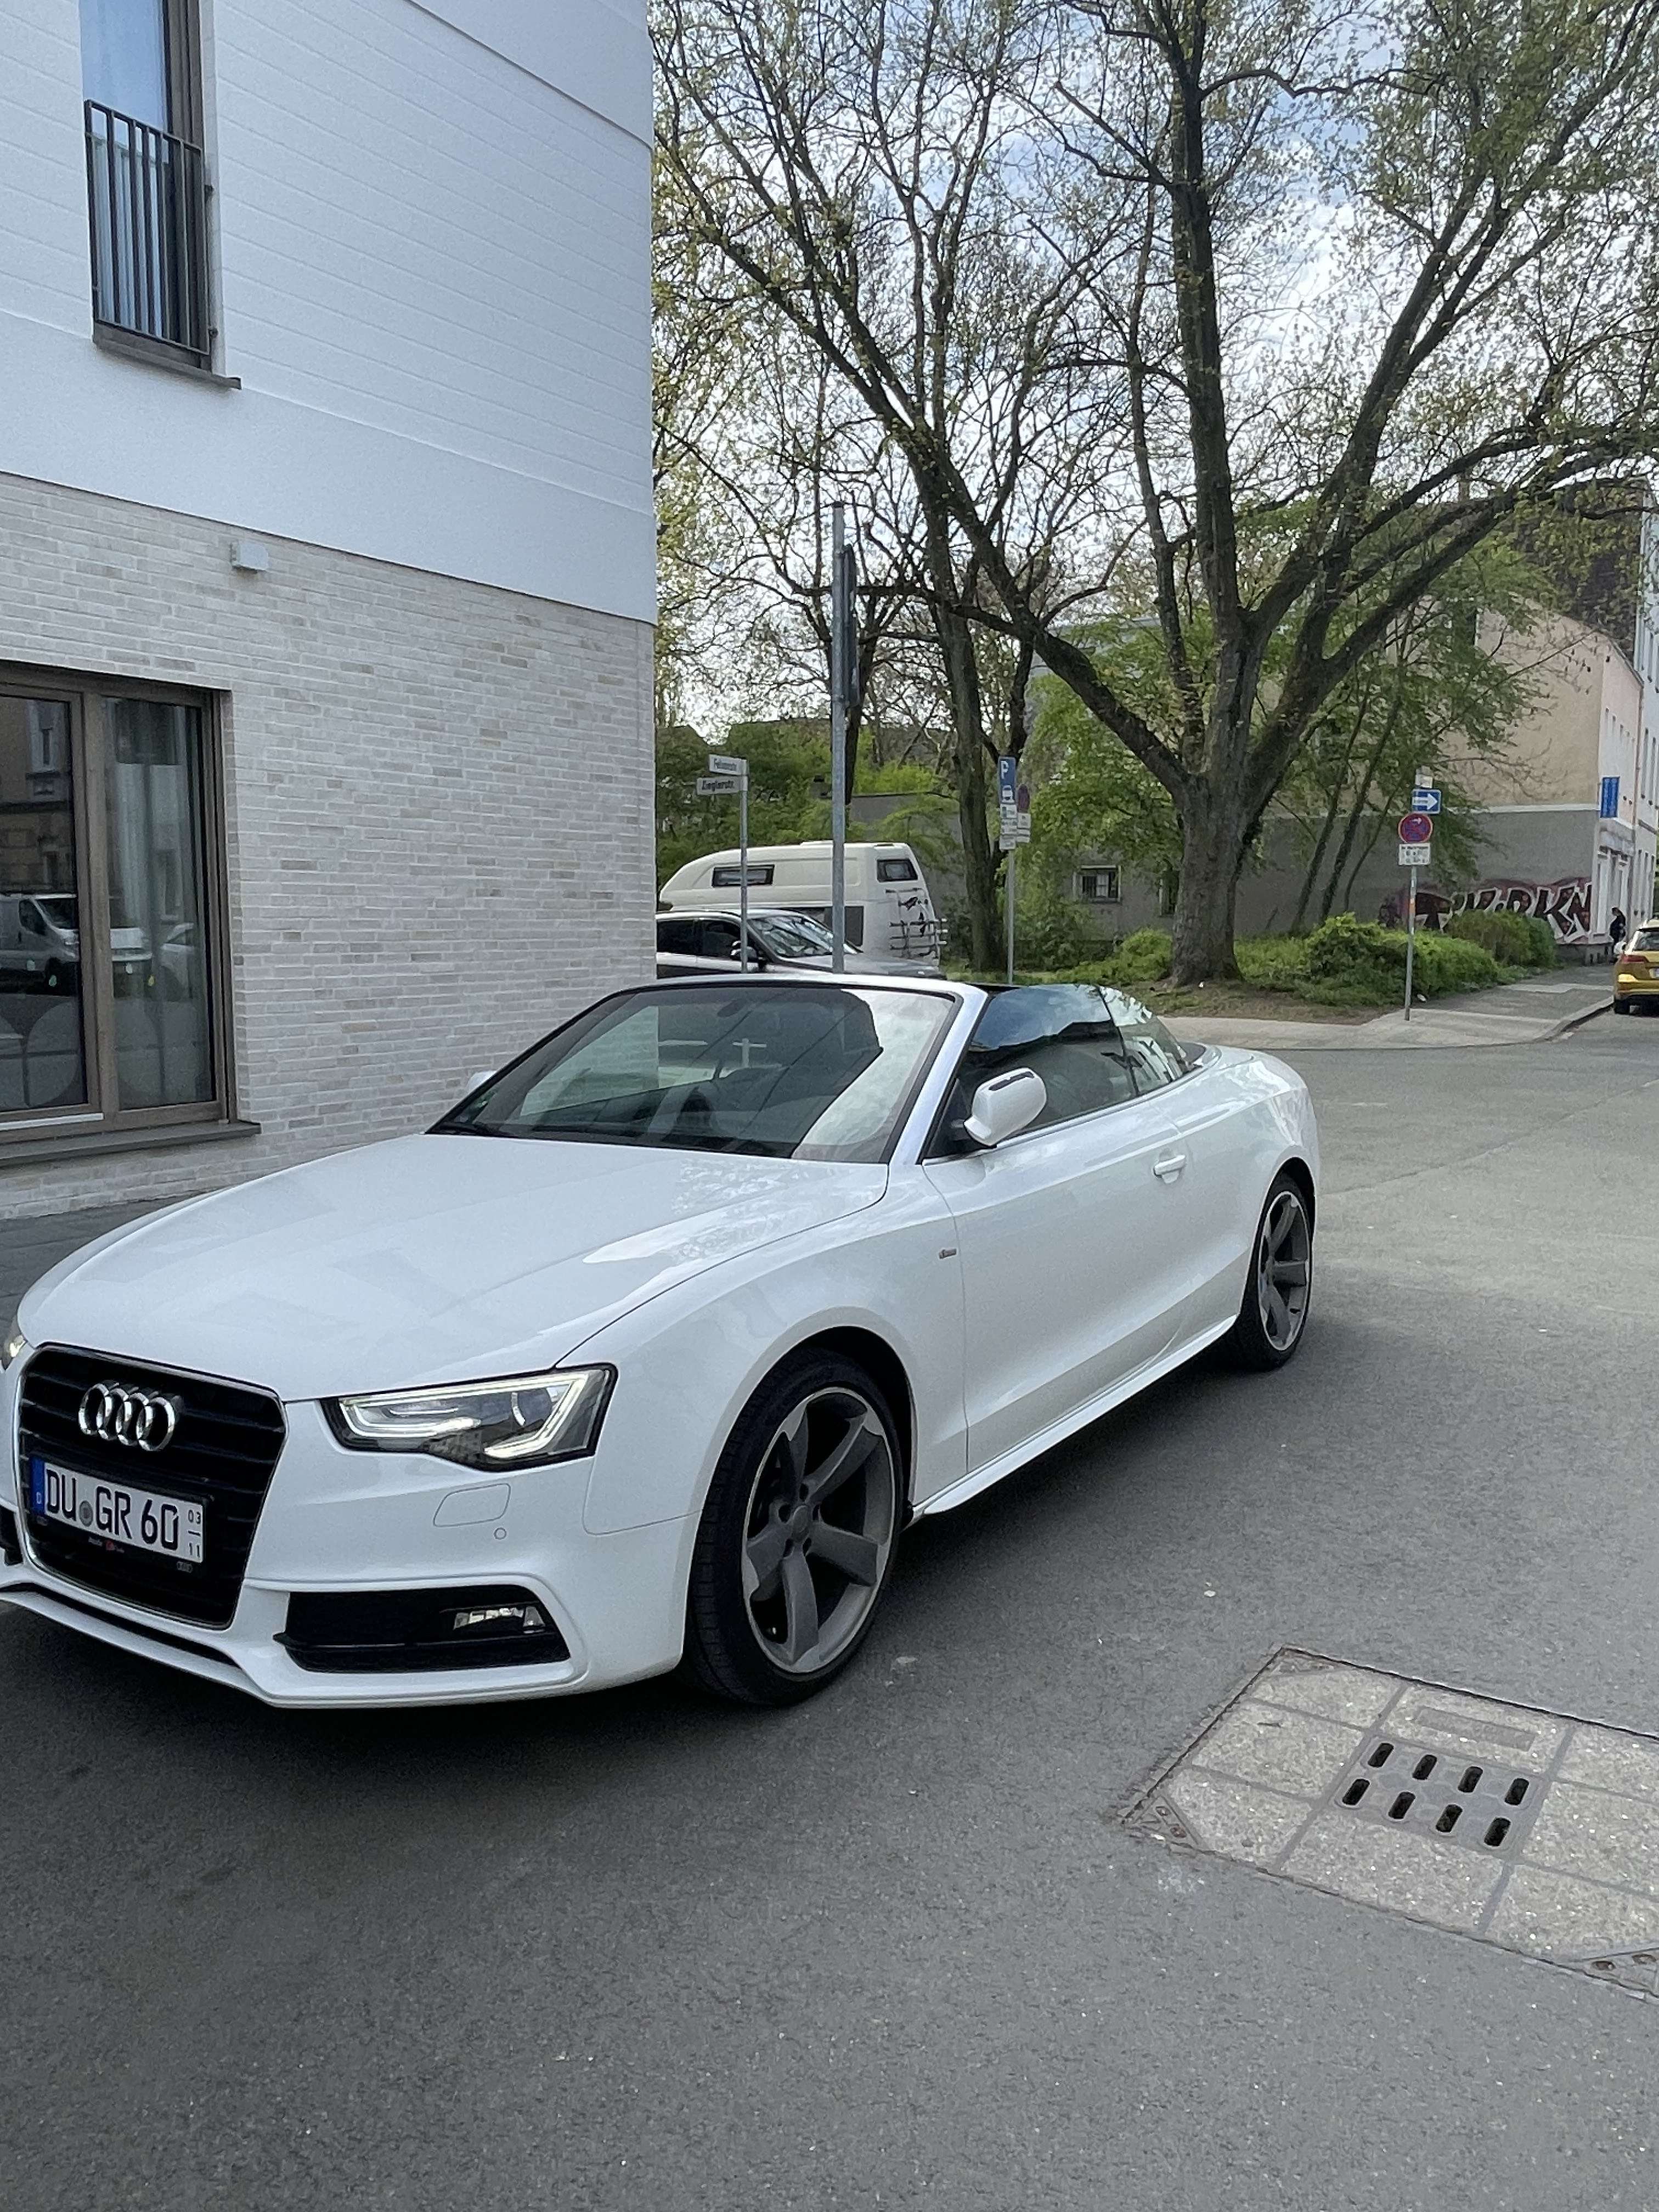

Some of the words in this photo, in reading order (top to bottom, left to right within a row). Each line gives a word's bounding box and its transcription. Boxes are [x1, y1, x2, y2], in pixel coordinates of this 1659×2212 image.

[1001, 760, 1009, 779] P
[47, 1470, 76, 1521] DU
[96, 1486, 132, 1539] GR
[141, 1499, 178, 1551] 60
[188, 1510, 200, 1525] 03
[189, 1543, 200, 1557] 11
